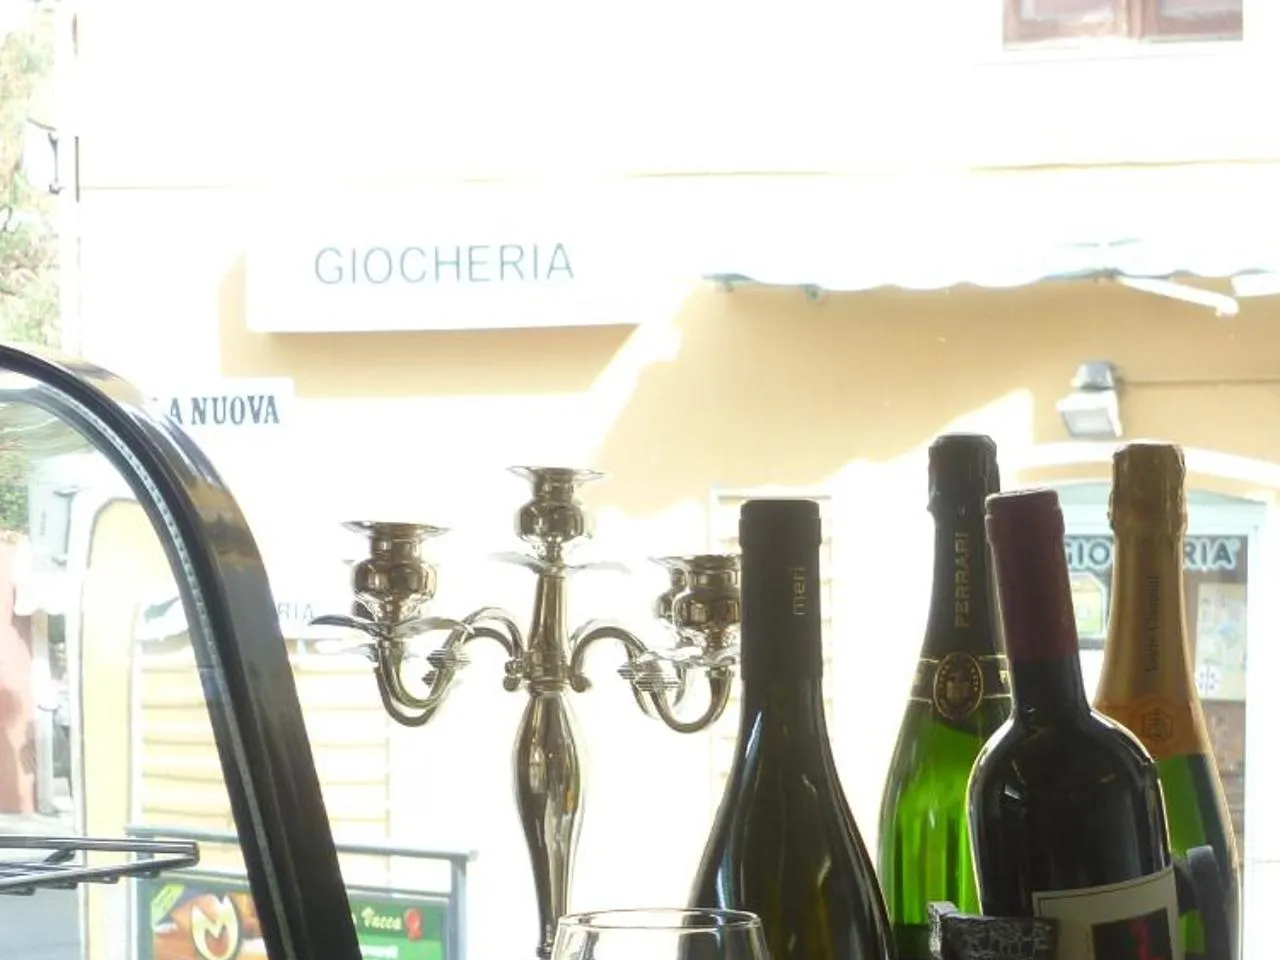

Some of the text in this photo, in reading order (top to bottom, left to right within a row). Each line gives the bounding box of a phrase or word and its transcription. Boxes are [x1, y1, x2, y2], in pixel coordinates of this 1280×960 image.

[314, 242, 574, 285] GIOCHERIA
[190, 395, 280, 426] NUOVA
[954, 531, 971, 628] FERRARI
